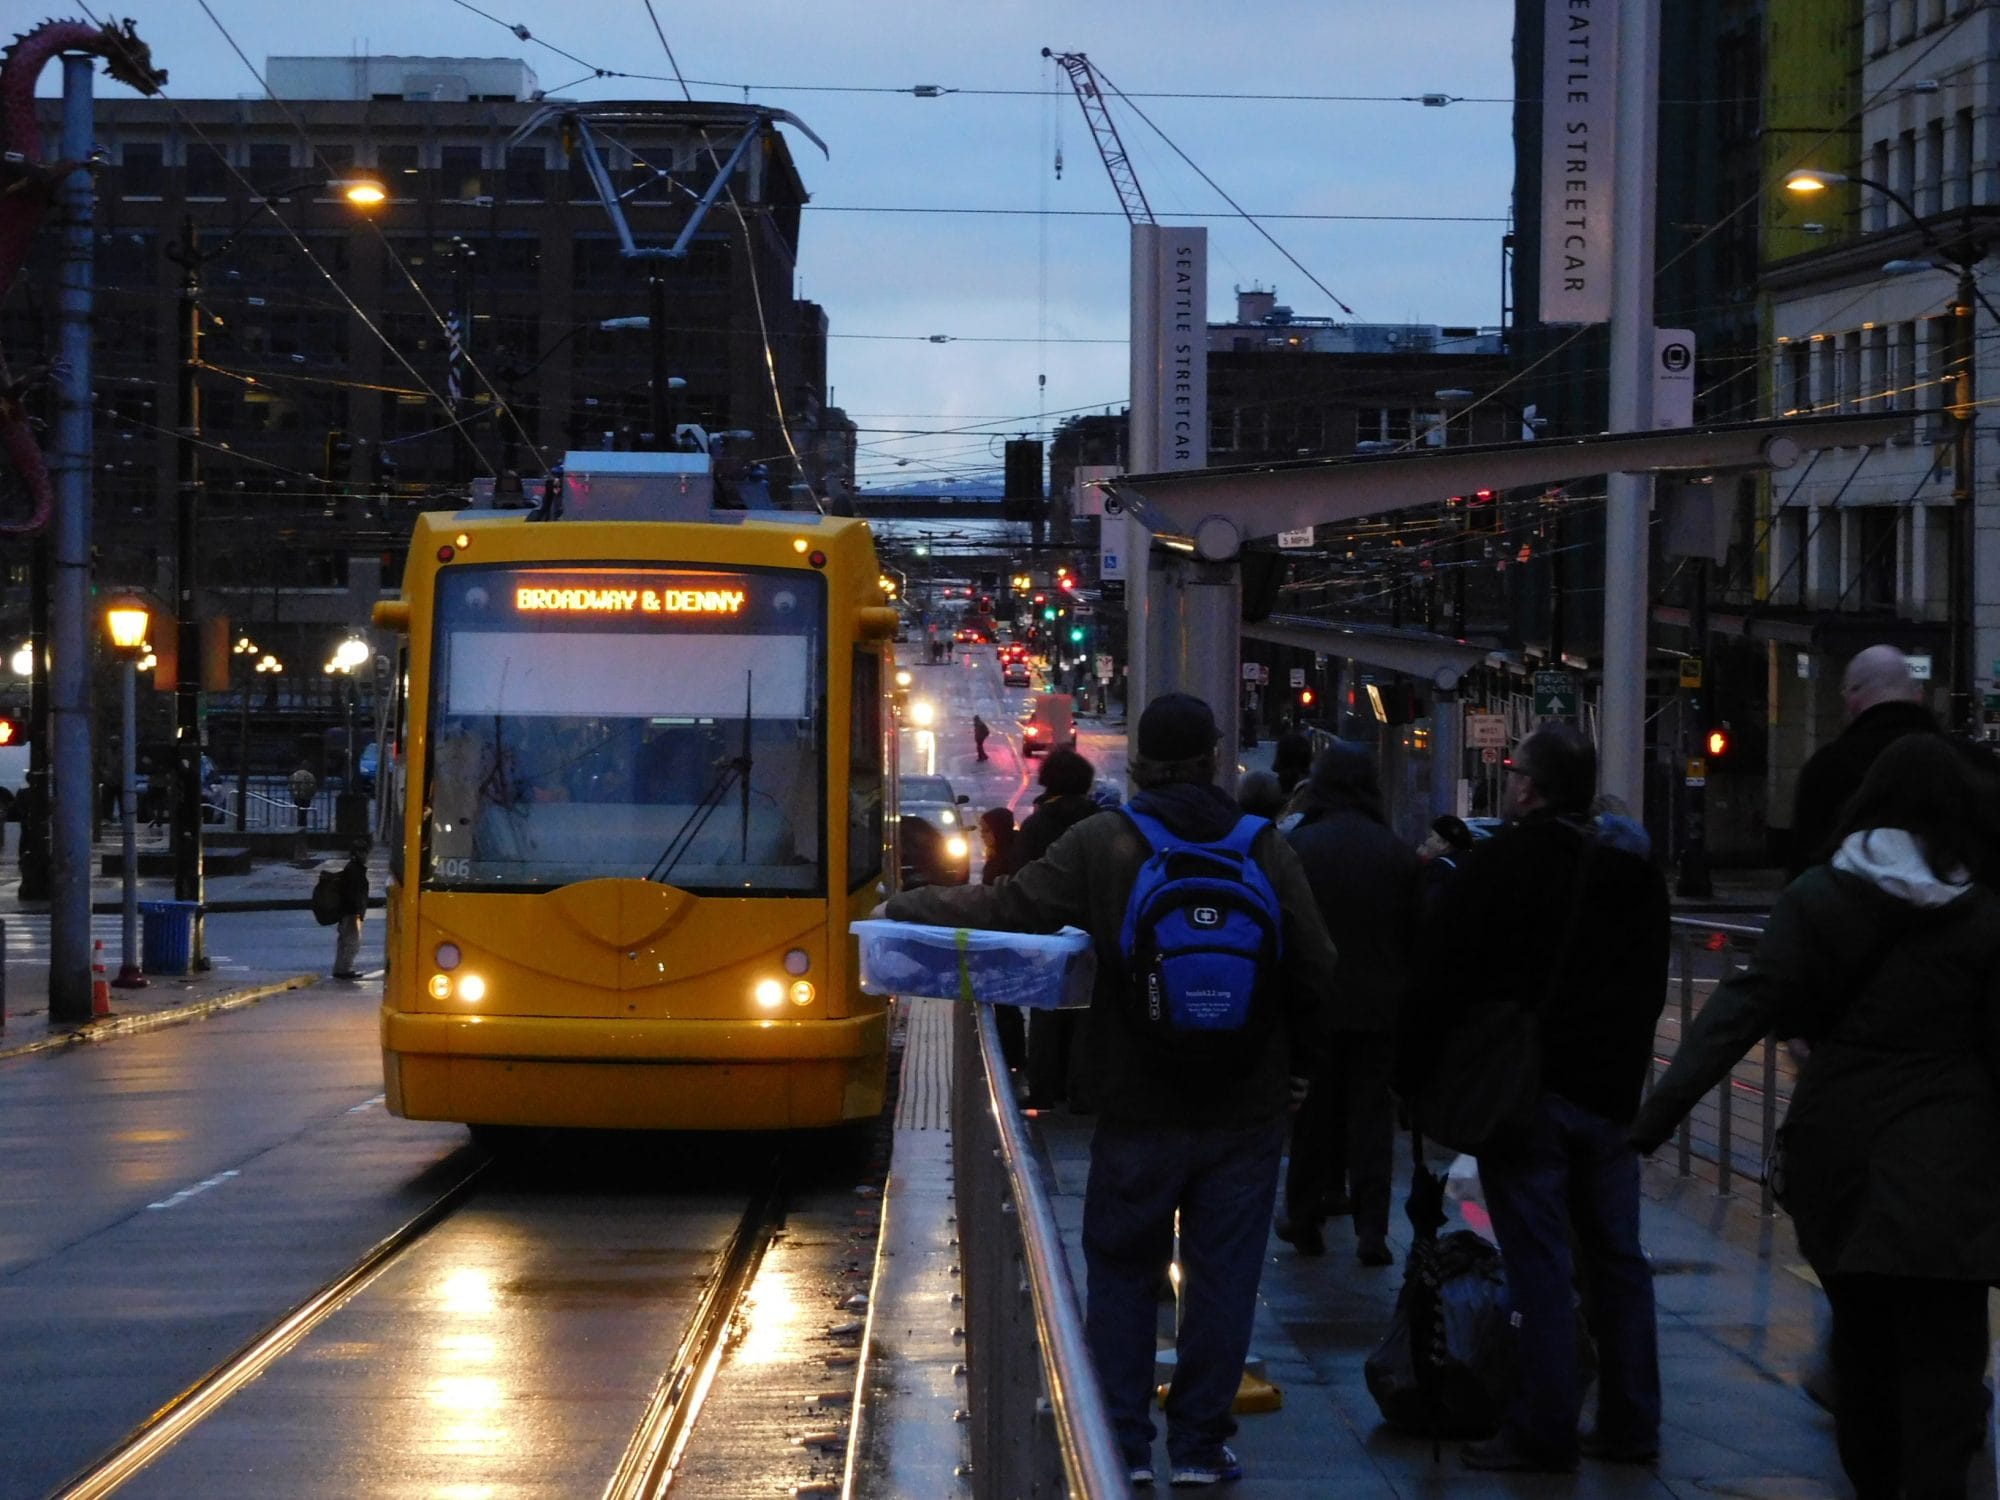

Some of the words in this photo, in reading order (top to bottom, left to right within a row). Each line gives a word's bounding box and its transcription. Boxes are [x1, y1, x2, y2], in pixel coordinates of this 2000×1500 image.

[1567, 0, 1590, 104] EATTLE
[1564, 122, 1588, 292] STREETCAR
[1176, 247, 1192, 333] SEATTLE
[1175, 345, 1191, 460] STREETCAR
[516, 588, 637, 610] BROADWAY
[642, 591, 661, 611] &
[665, 590, 744, 612] DENNY
[1903, 661, 1928, 673] ffice
[434, 858, 470, 877] 406
